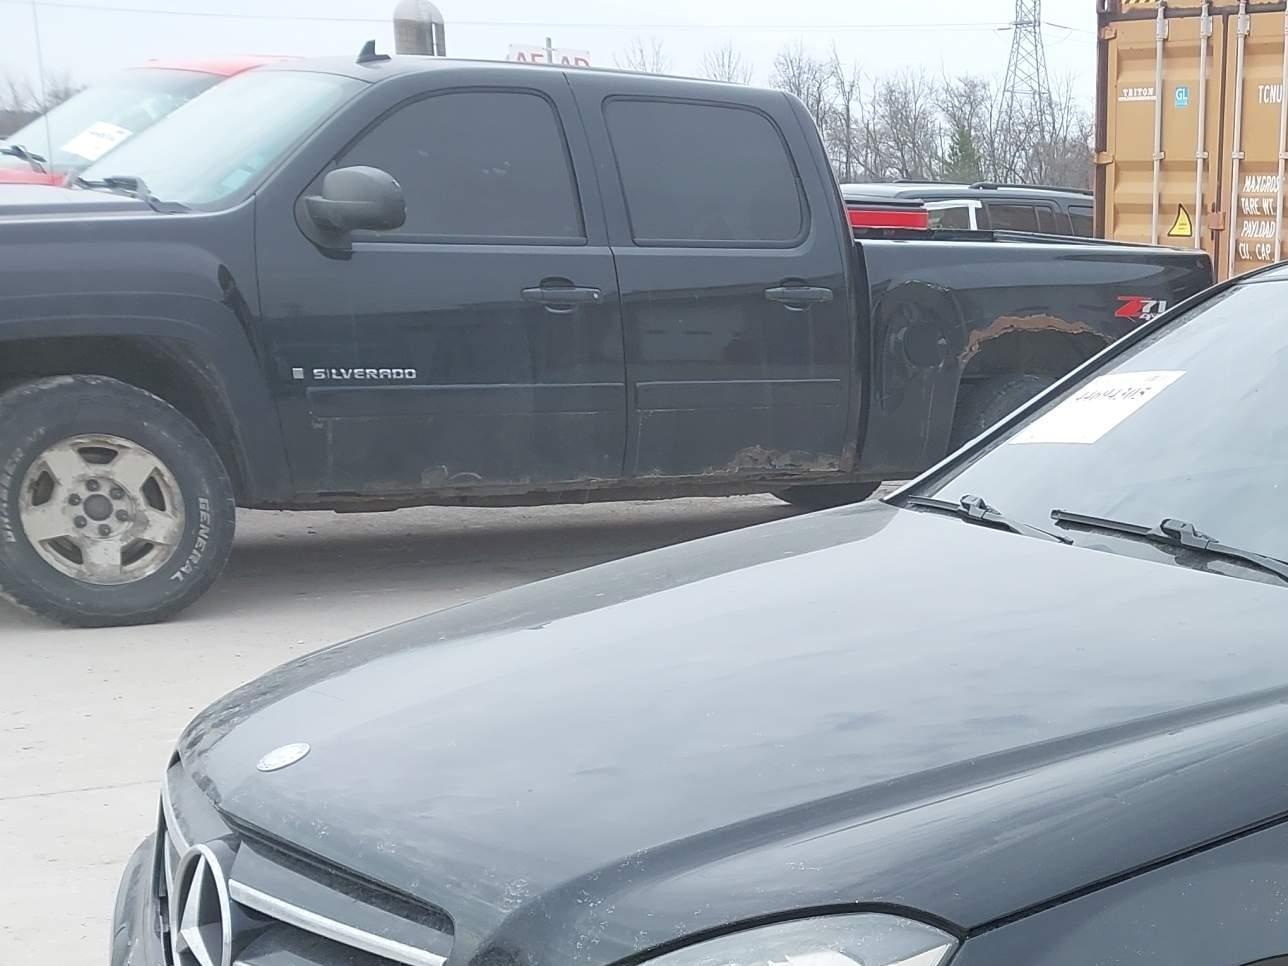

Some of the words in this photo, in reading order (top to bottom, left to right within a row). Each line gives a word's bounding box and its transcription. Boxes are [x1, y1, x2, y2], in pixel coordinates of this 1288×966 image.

[1122, 87, 1154, 97] TRITON
[1175, 88, 1188, 100] GL
[1258, 85, 1282, 103] TCNU
[1243, 175, 1285, 193] MAXGROS
[1241, 198, 1261, 215] TARE
[1241, 221, 1276, 238] PAYLOAD
[1239, 243, 1252, 260] CU.
[1114, 296, 1167, 317] Z71
[312, 368, 417, 380] SILVERADO
[169, 497, 211, 582] GENERAL
